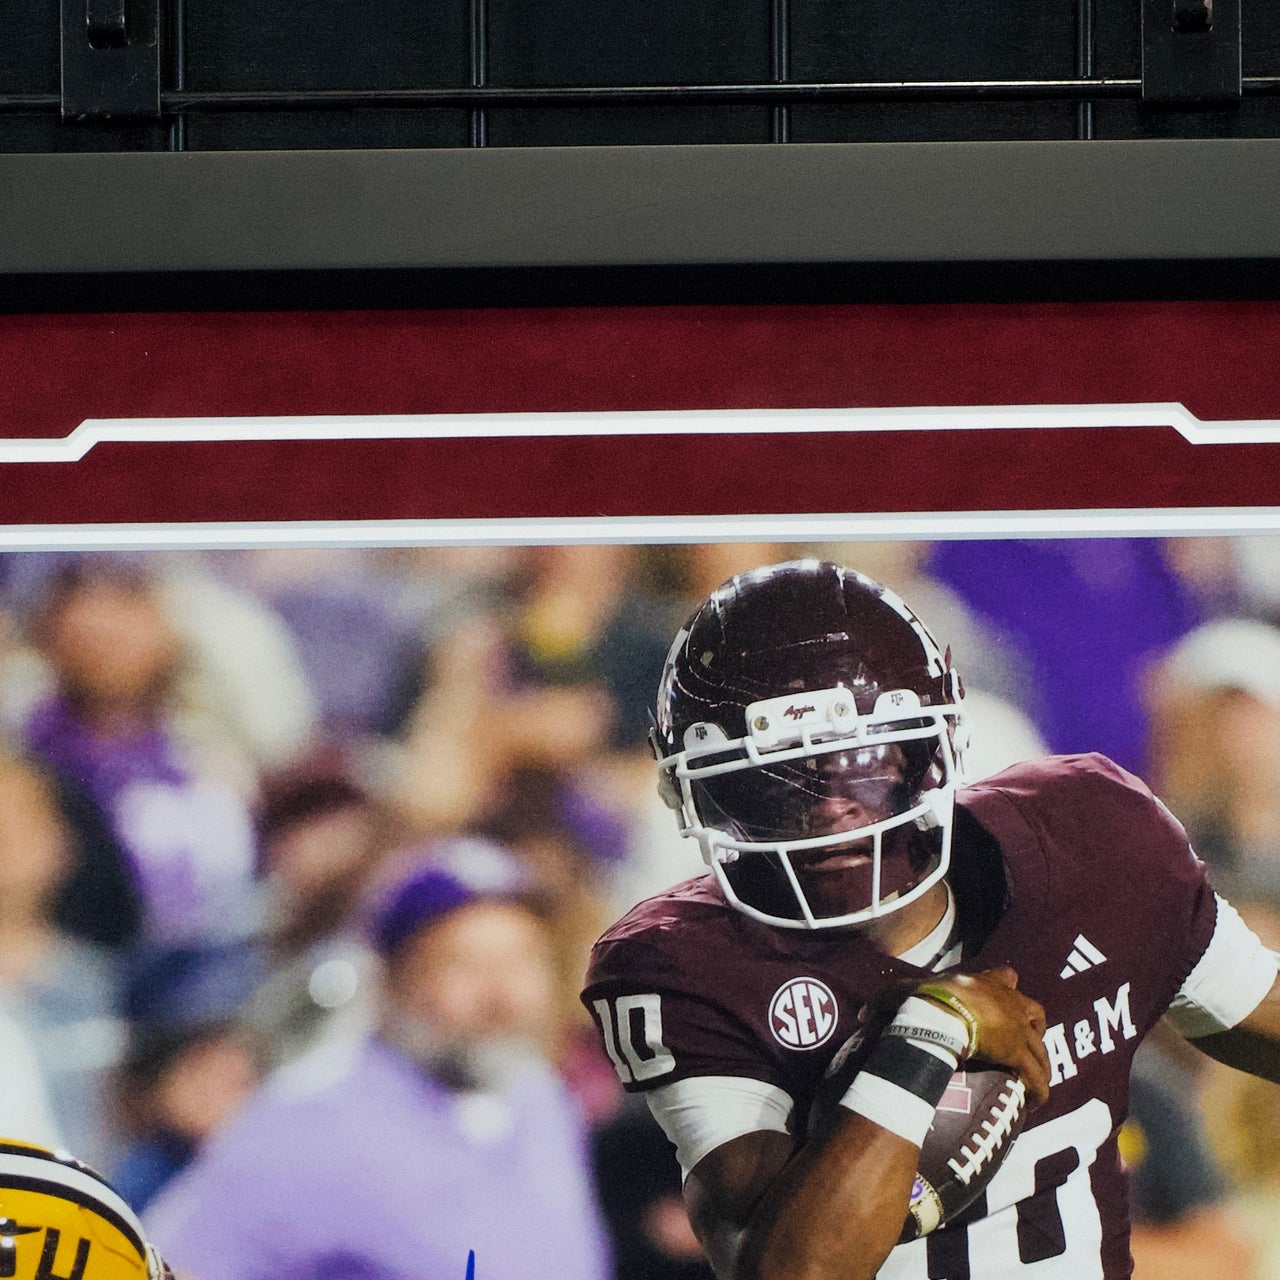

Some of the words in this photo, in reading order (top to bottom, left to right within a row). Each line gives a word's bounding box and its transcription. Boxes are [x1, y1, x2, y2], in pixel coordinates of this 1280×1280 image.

[592, 993, 677, 1083] 10
[773, 982, 834, 1046] SEC
[911, 1027, 955, 1046] STRONG
[1042, 982, 1138, 1088] A&M
